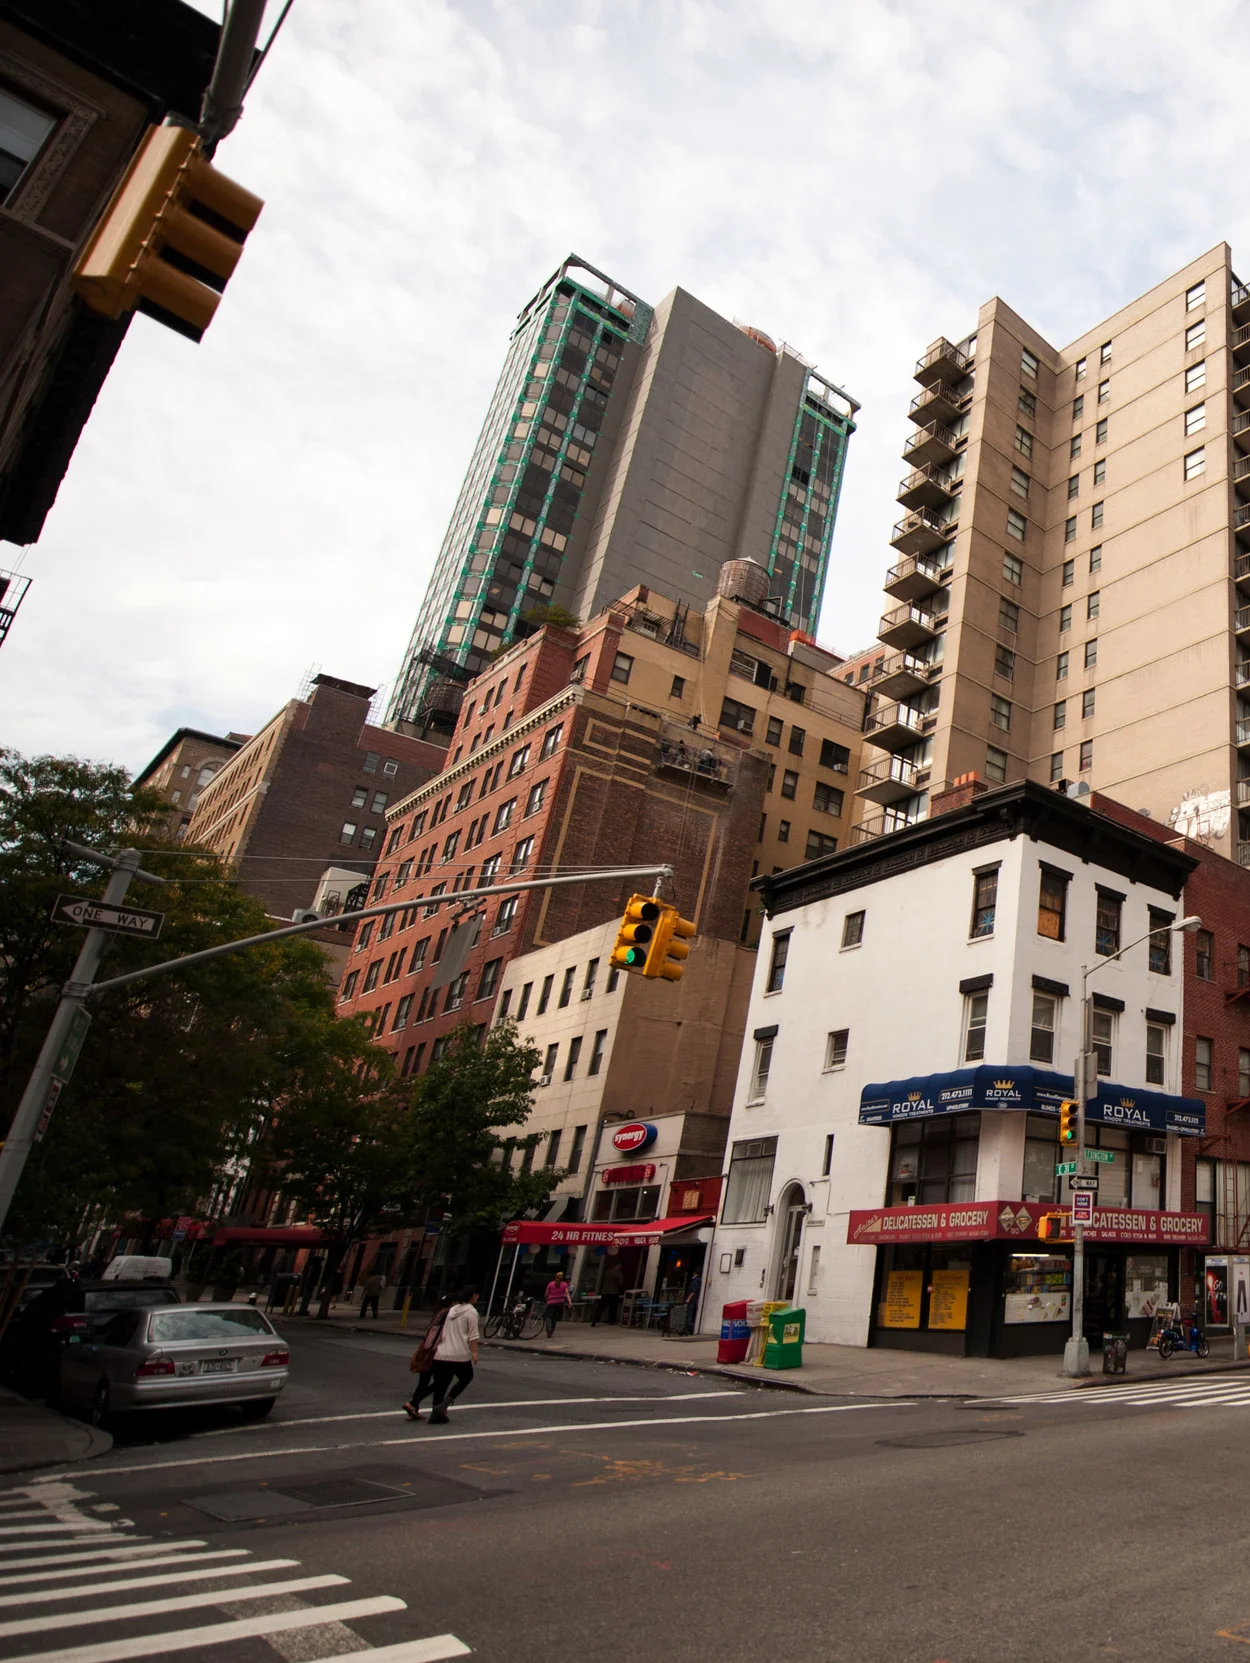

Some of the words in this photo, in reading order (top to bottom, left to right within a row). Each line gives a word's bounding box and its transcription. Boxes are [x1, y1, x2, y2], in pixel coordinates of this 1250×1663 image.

[72, 906, 104, 920] ONE
[117, 913, 149, 928] WAY
[986, 1089, 1022, 1097] ROYAL
[892, 1099, 934, 1114] ROYAL
[1103, 1104, 1150, 1122] ROYAL
[1123, 1118, 1150, 1127] TREATMENTS
[614, 1129, 645, 1143] synergy
[883, 1213, 938, 1230] DELICATESSEN
[940, 1213, 946, 1229] &
[949, 1211, 988, 1227] GROCERY
[1150, 1215, 1156, 1230] &
[1160, 1217, 1203, 1233] GROCERY
[551, 1231, 564, 1240] 24
[567, 1231, 579, 1241] HR
[1214, 1280, 1223, 1290] GO
